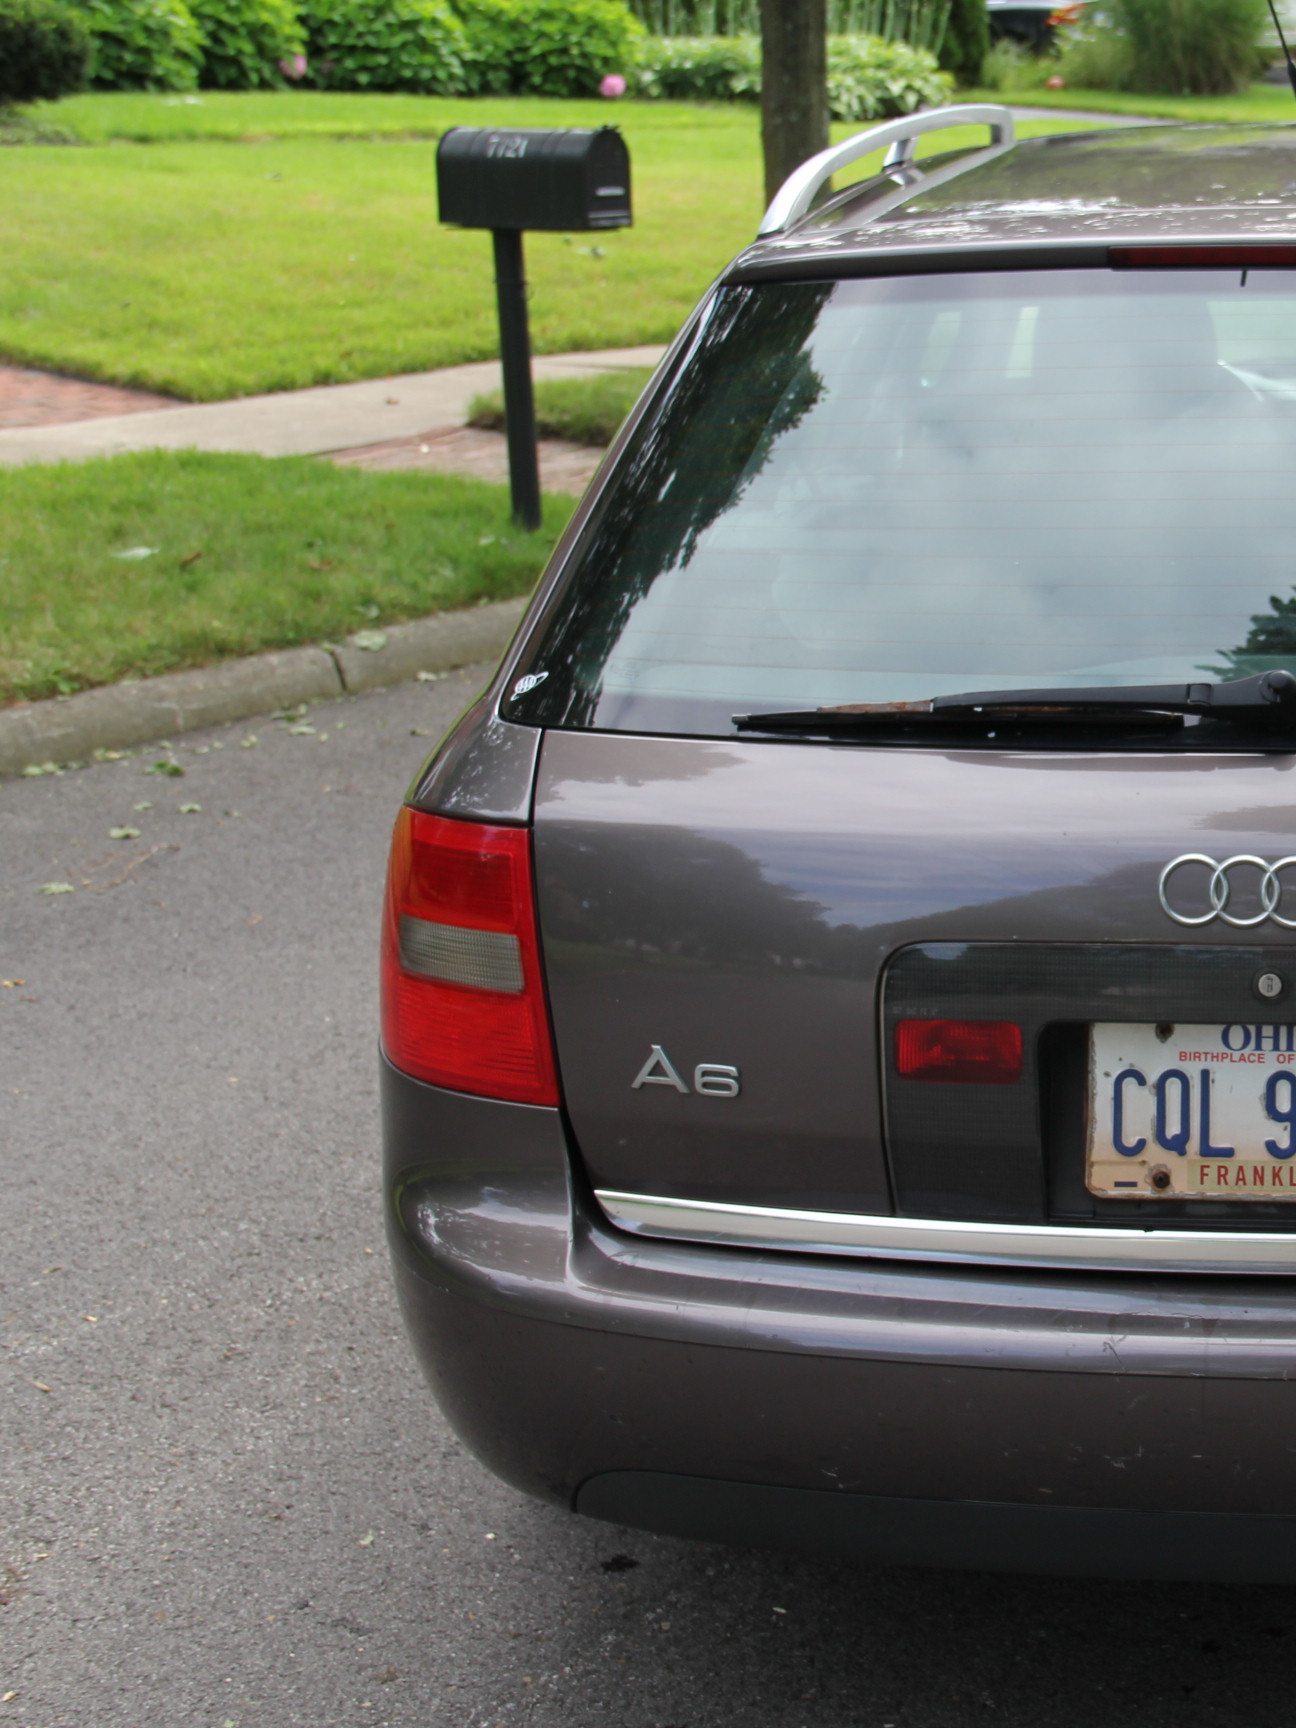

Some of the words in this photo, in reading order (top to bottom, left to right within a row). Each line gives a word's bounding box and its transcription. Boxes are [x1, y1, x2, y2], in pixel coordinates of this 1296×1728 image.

[631, 1044, 739, 1097] A6
[1178, 1051, 1266, 1065] BIRTHPLACE
[1276, 1054, 1295, 1065] OF
[1112, 1068, 1235, 1159] CQL
